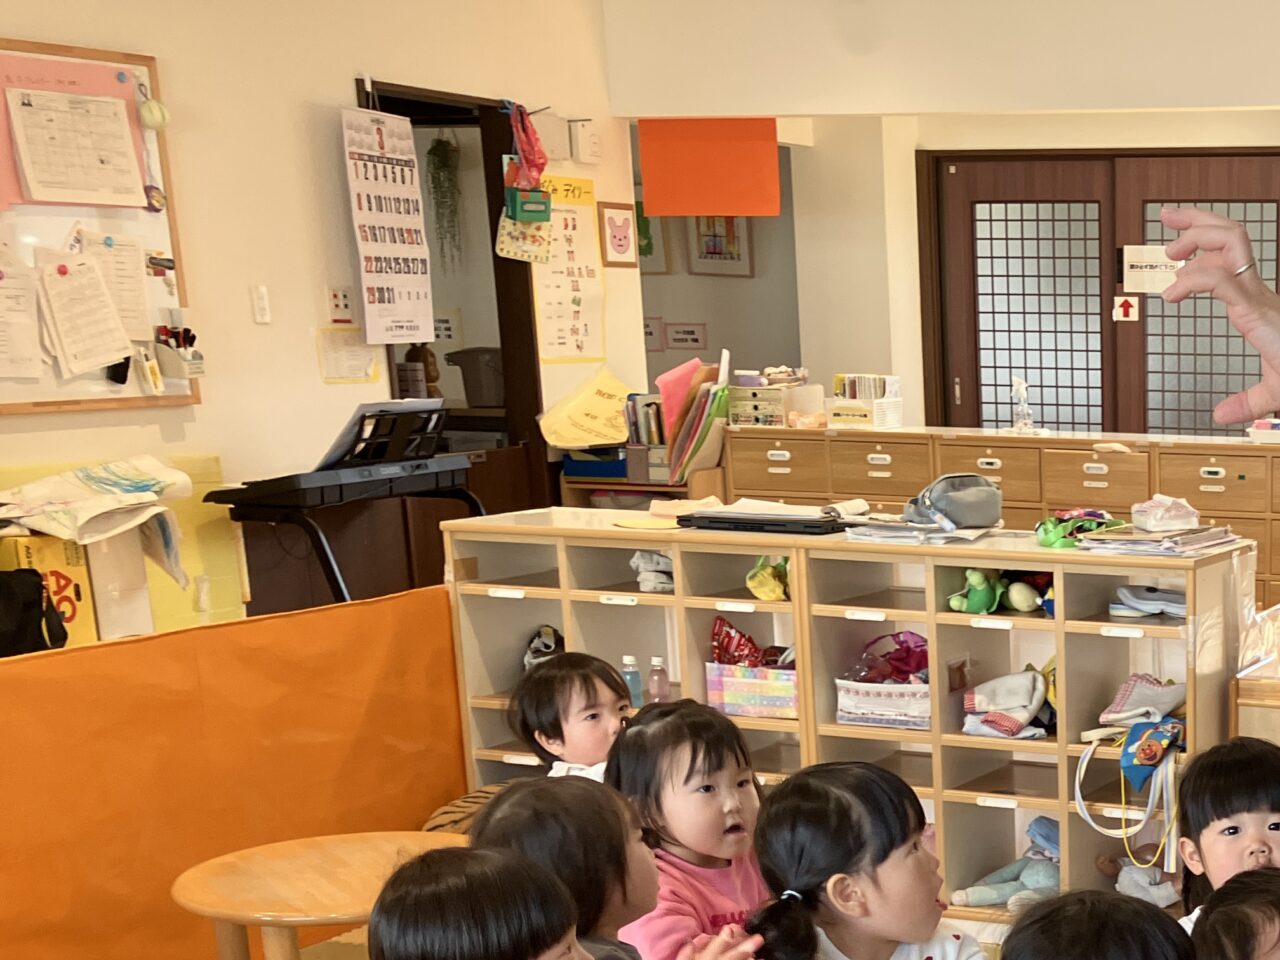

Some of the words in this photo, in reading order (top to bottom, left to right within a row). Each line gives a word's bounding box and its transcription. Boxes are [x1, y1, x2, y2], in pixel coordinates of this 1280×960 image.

[375, 127, 385, 150] 3
[354, 162, 359, 179] 1
[363, 163, 369, 180] 2
[373, 164, 379, 181] 3
[383, 165, 388, 182] 4
[391, 166, 397, 183] 5
[401, 168, 406, 184] 6
[409, 169, 414, 185] 7
